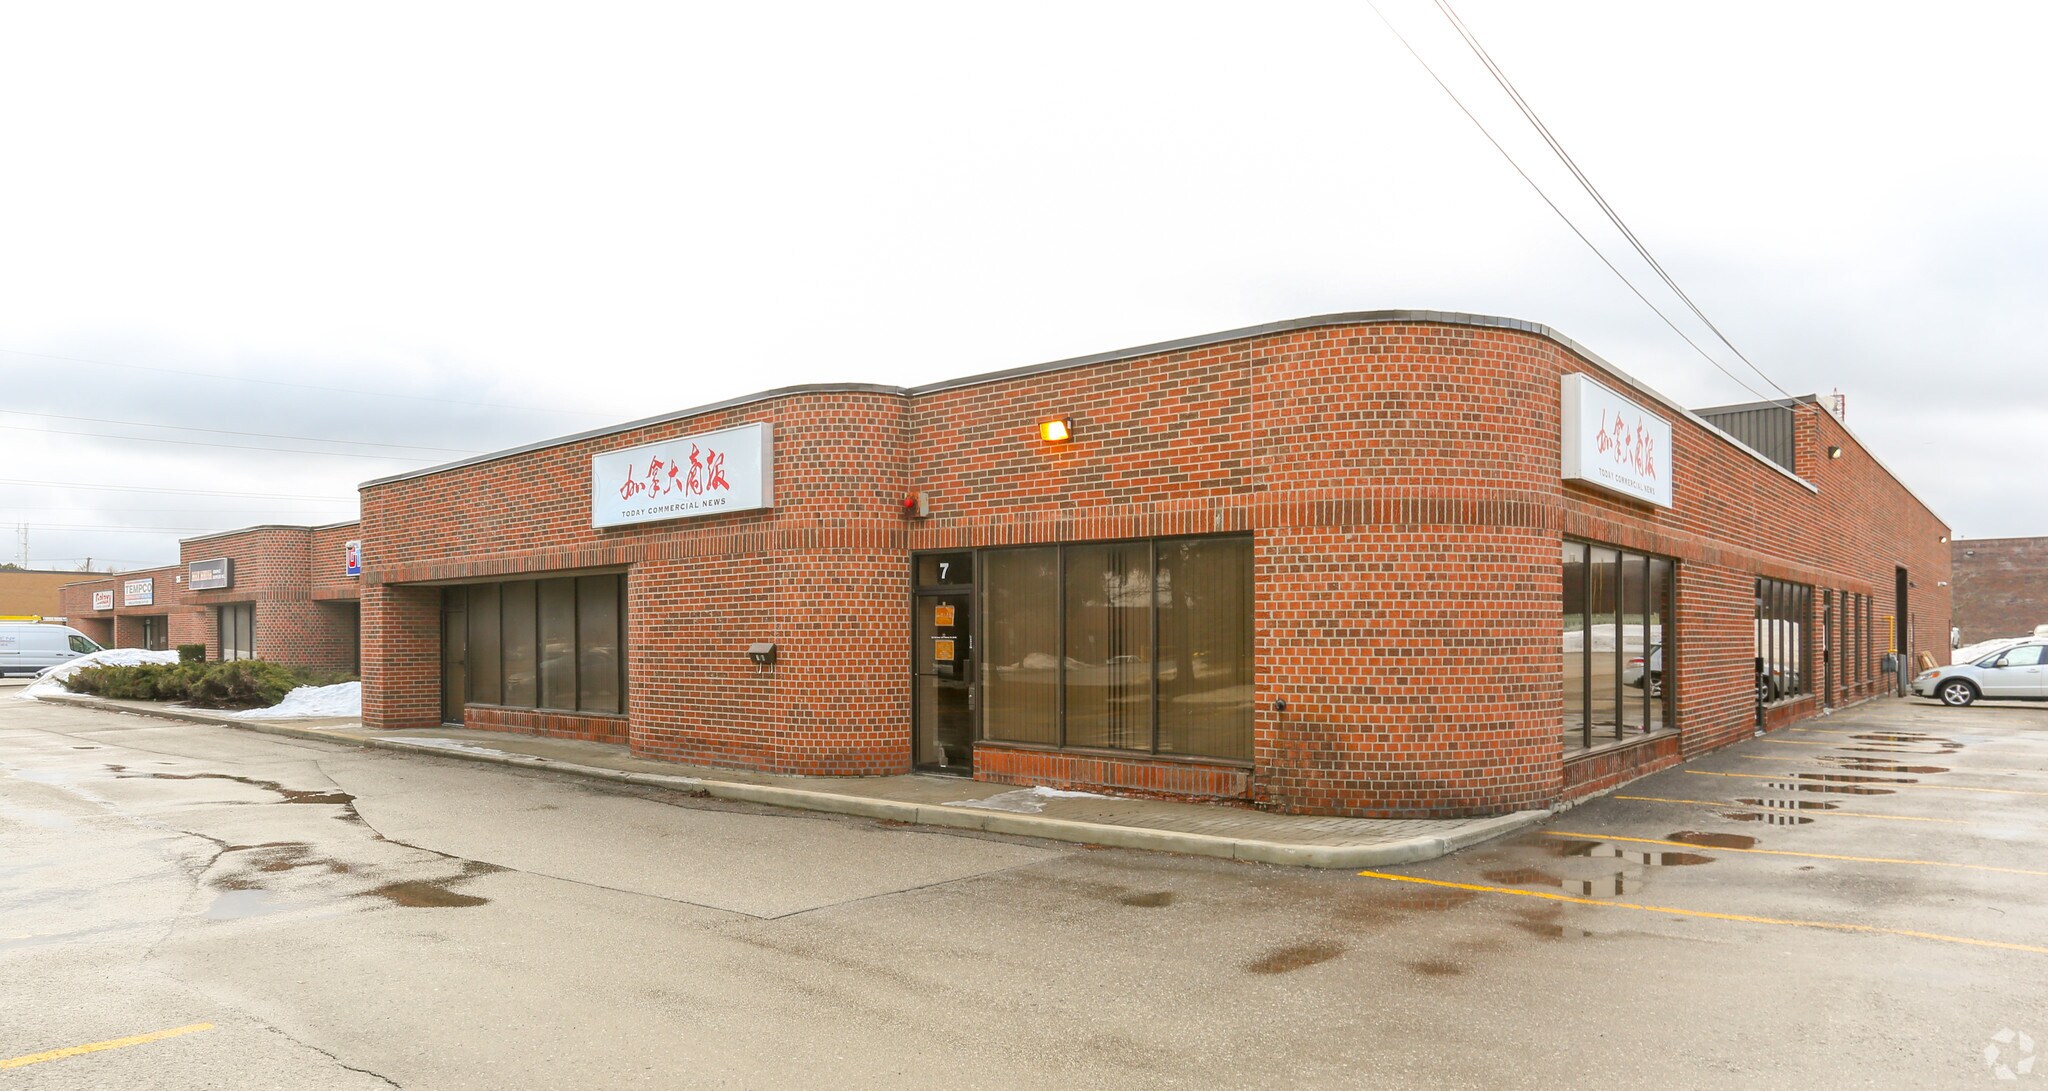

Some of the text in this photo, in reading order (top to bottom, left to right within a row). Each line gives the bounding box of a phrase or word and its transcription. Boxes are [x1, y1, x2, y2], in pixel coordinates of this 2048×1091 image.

[1598, 467, 1656, 495] TODAY COMMERCIAL NEWS
[621, 497, 726, 518] TODAY COMMERCIAL NEWS
[939, 562, 949, 580] 7
[125, 583, 152, 594] TEMPCO
